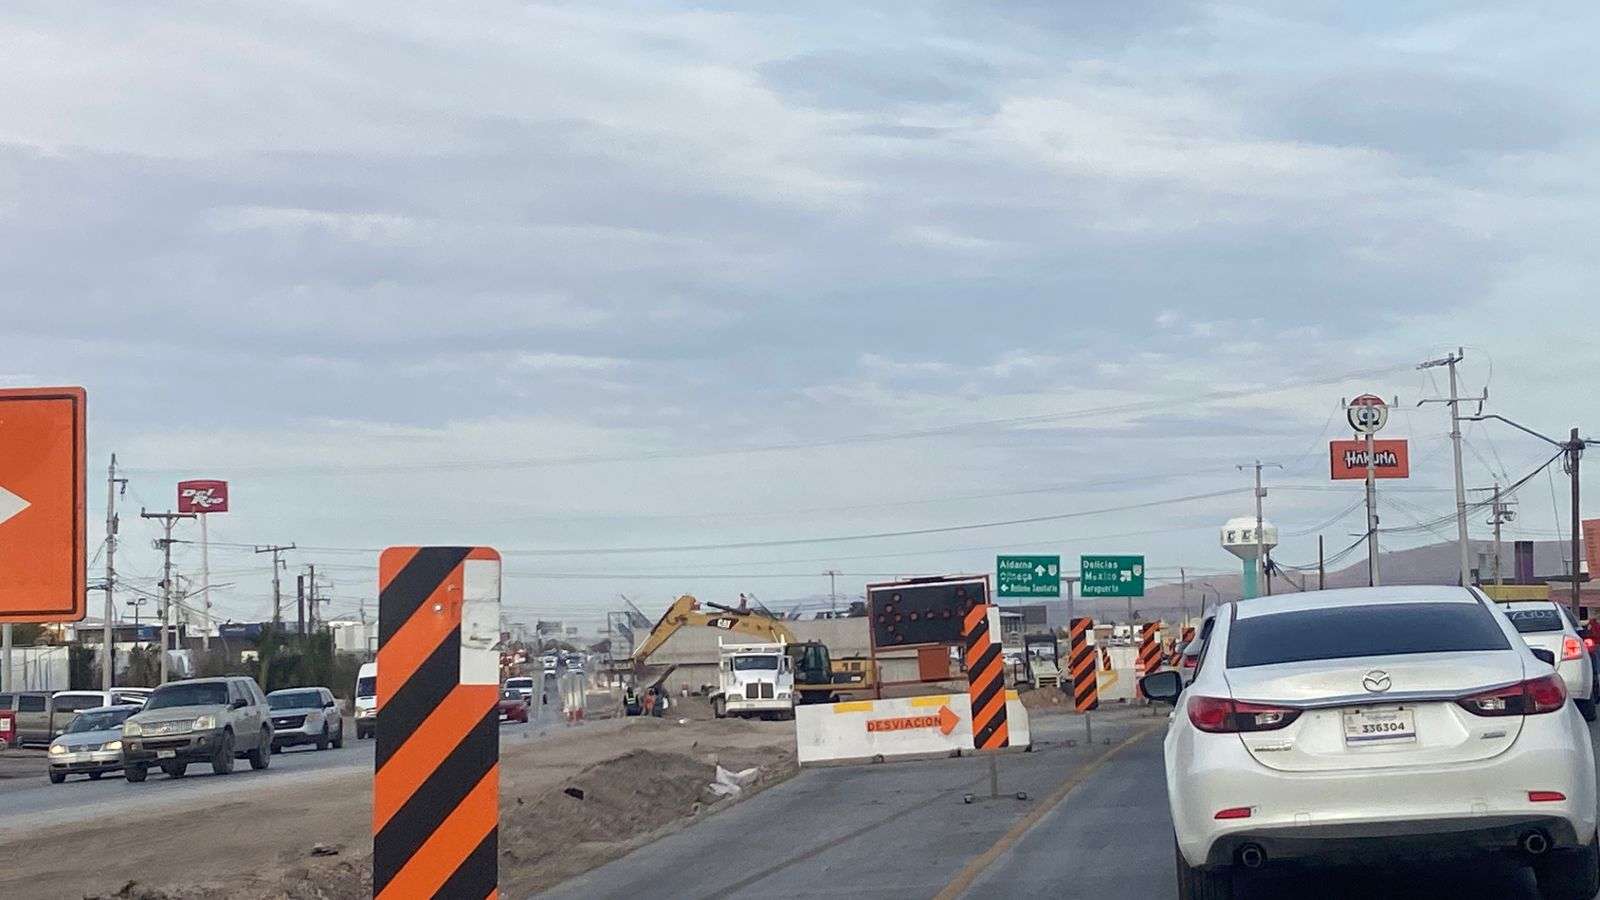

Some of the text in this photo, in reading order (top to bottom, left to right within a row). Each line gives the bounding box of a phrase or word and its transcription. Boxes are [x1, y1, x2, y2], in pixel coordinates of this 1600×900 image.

[1000, 560, 1033, 569] Aldama
[1083, 560, 1118, 569] Delicias
[1362, 722, 1405, 733] 336304
